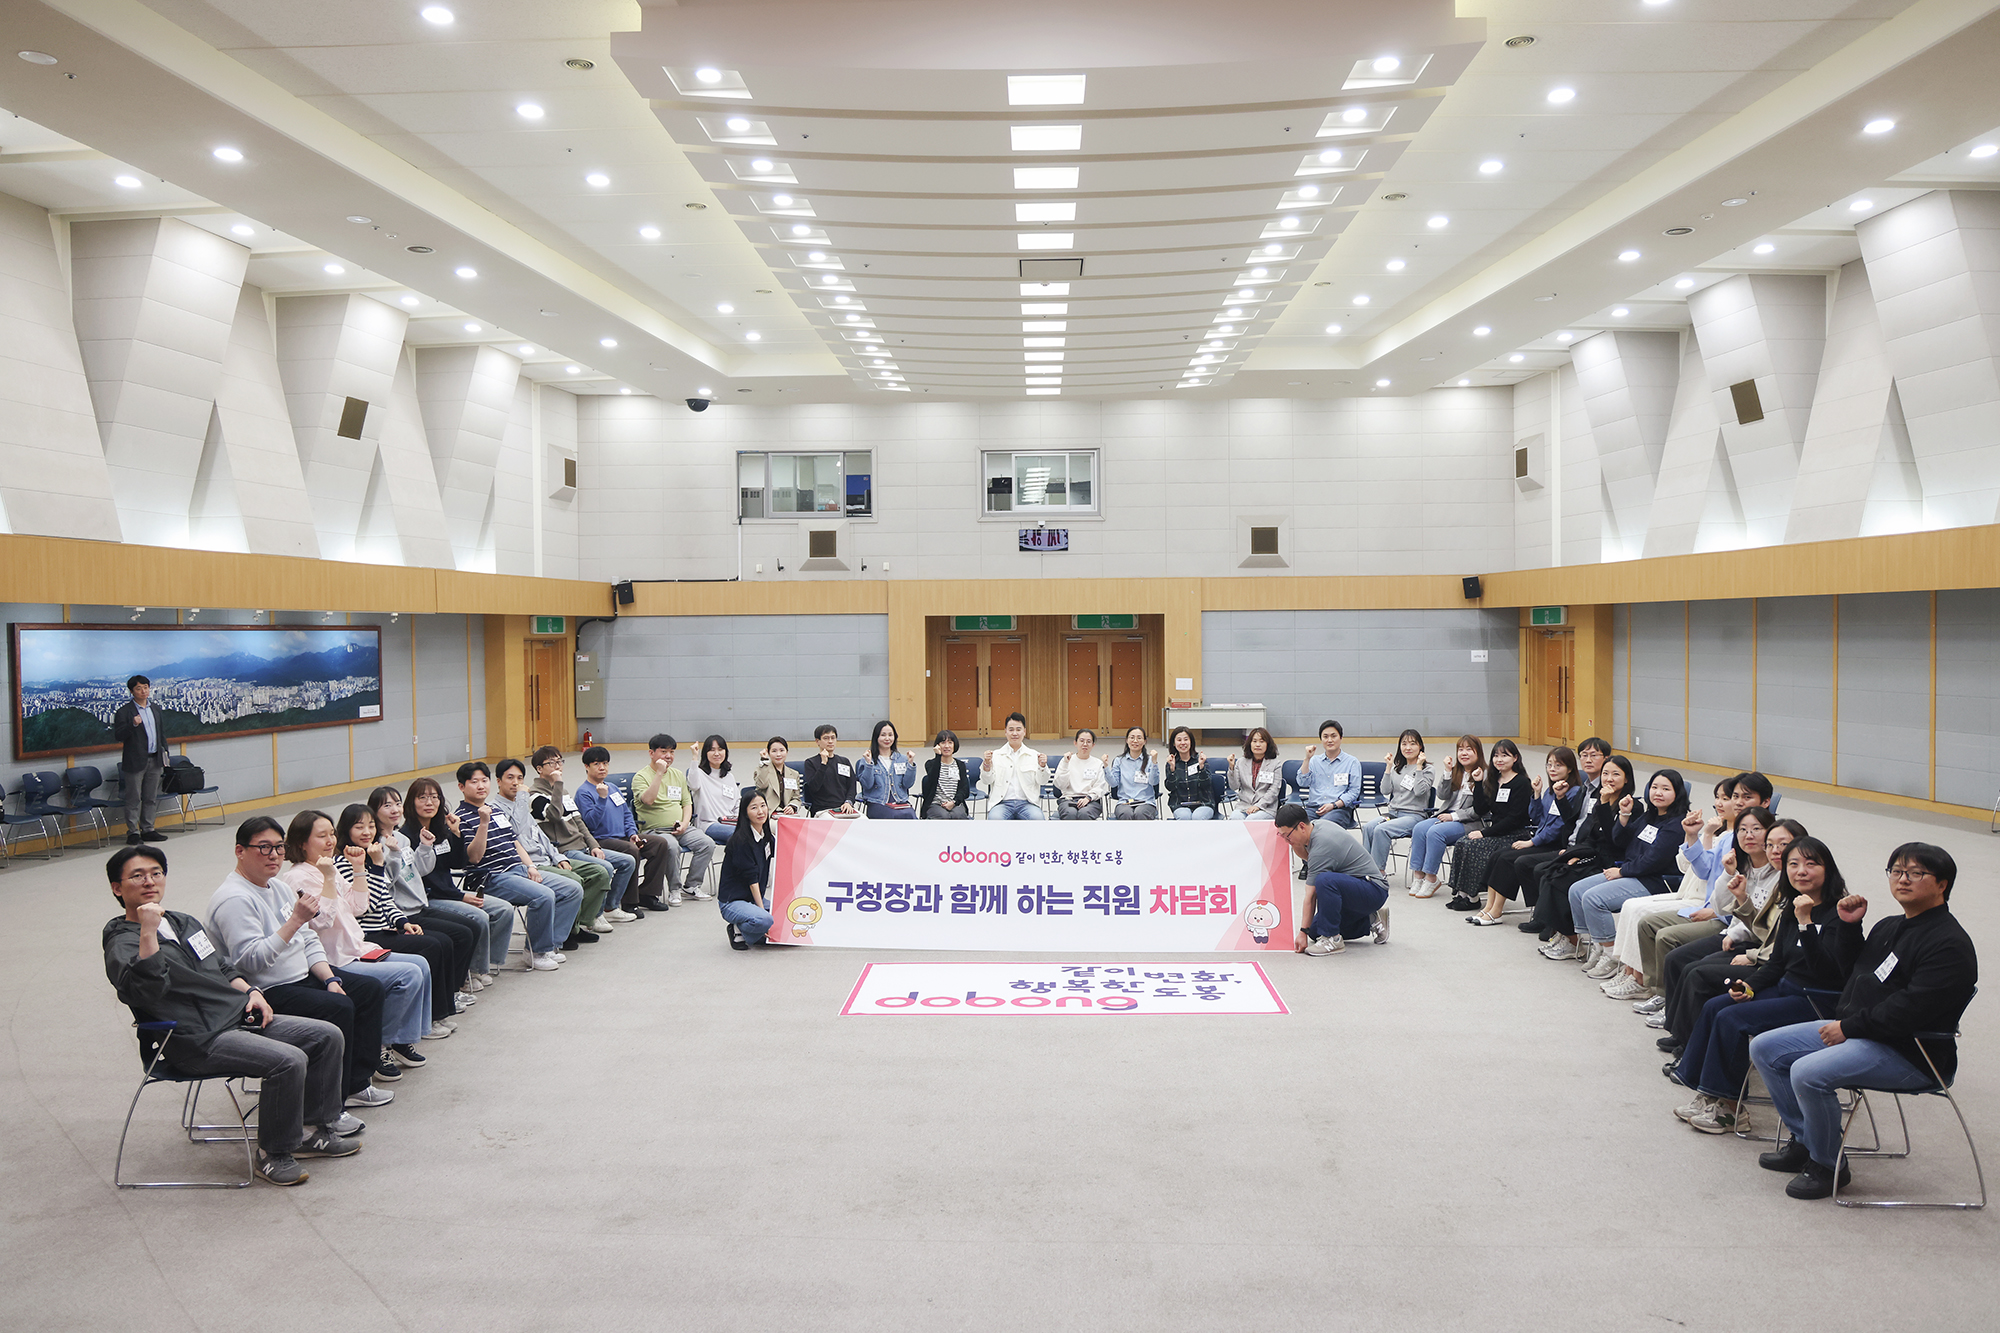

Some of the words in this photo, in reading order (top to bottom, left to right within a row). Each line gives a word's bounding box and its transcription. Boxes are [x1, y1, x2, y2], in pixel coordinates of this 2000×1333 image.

[938, 845, 1012, 868] dobong
[1015, 851, 1035, 865] 같이
[1067, 850, 1102, 865] 행복한
[1104, 850, 1123, 866] 도봉
[825, 881, 943, 914] 구청장과
[950, 884, 1008, 915] 함께
[1017, 884, 1074, 915] 하는
[1083, 885, 1141, 916] 직원
[1149, 884, 1237, 916] 차담회
[1061, 966, 1136, 978] 같이
[1144, 970, 1242, 984] 변화,
[1009, 979, 1145, 994] 행복한
[1153, 985, 1225, 1001] 도봉
[874, 991, 1139, 1011] dobong
[313, 1138, 330, 1150] N
[262, 1162, 275, 1176] N
